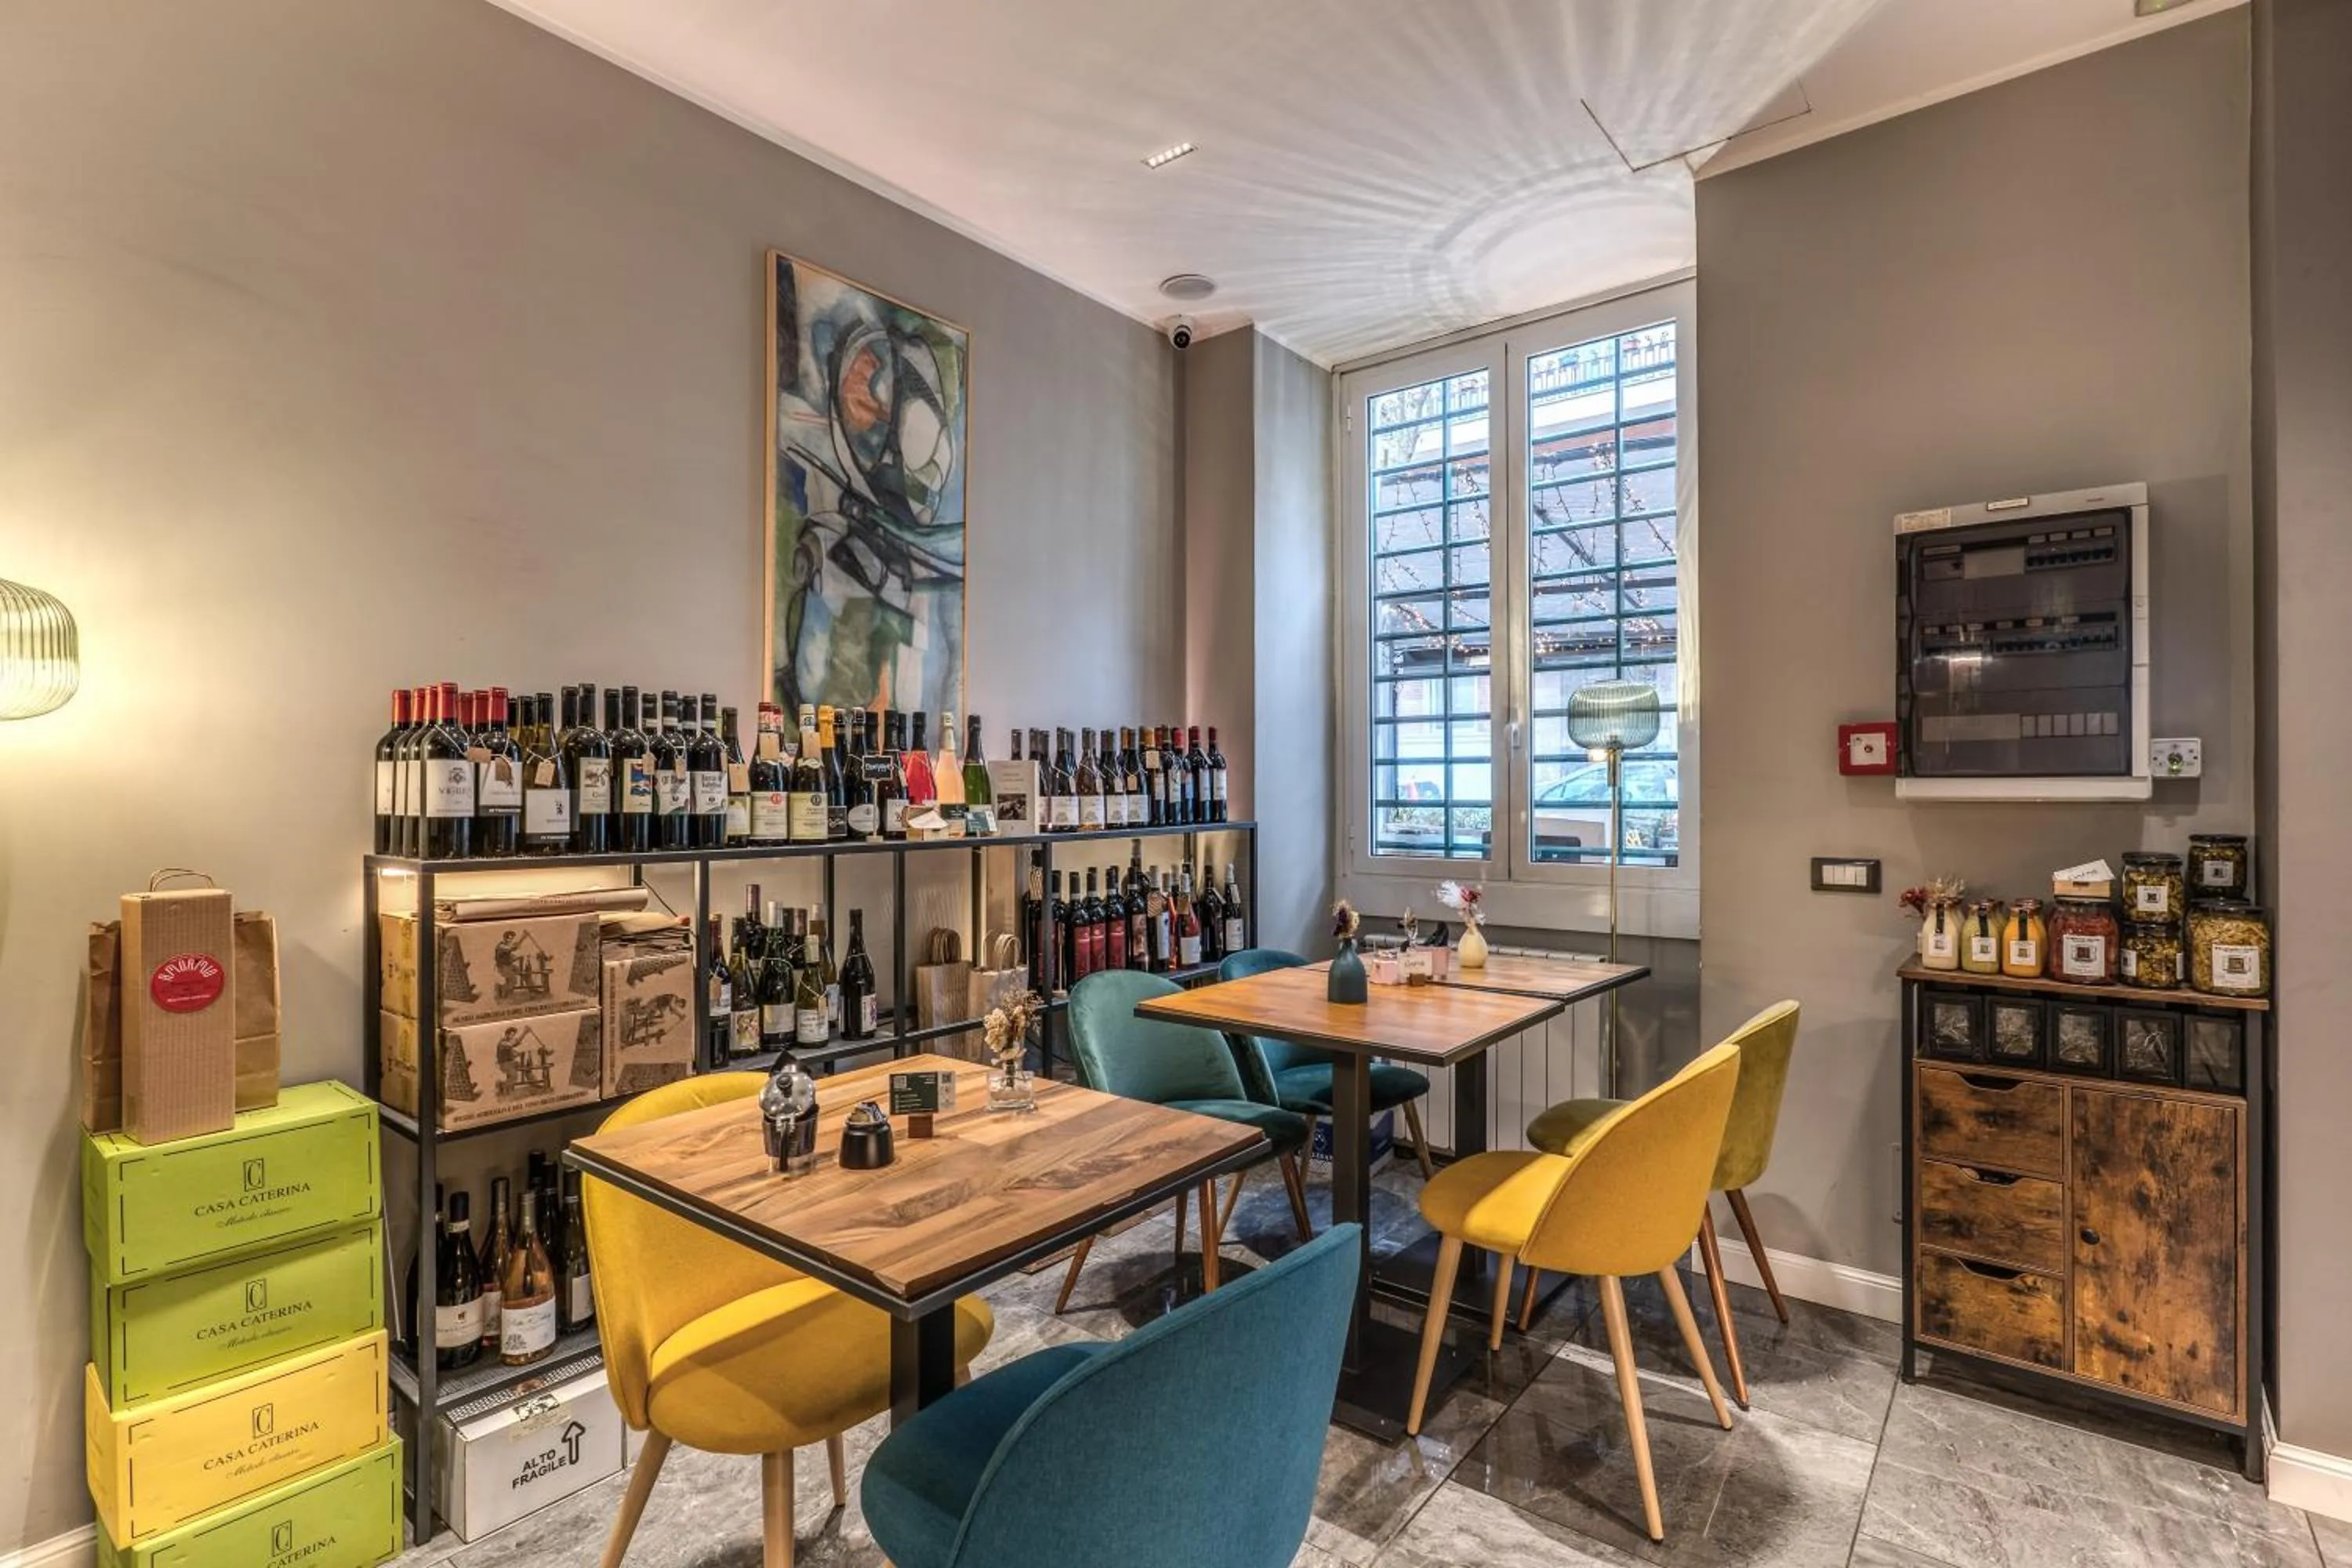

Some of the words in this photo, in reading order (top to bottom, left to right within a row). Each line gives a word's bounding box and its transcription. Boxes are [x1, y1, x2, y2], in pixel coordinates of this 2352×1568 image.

[194, 1200, 235, 1217] CASA
[238, 1181, 311, 1207] CATERINA
[196, 1320, 238, 1341] CASA
[240, 1300, 314, 1328] CATERINA
[202, 1448, 245, 1471] CASA
[247, 1420, 321, 1455] CATERINA
[522, 1448, 556, 1473] ALTO
[512, 1455, 567, 1490] FRAGILE
